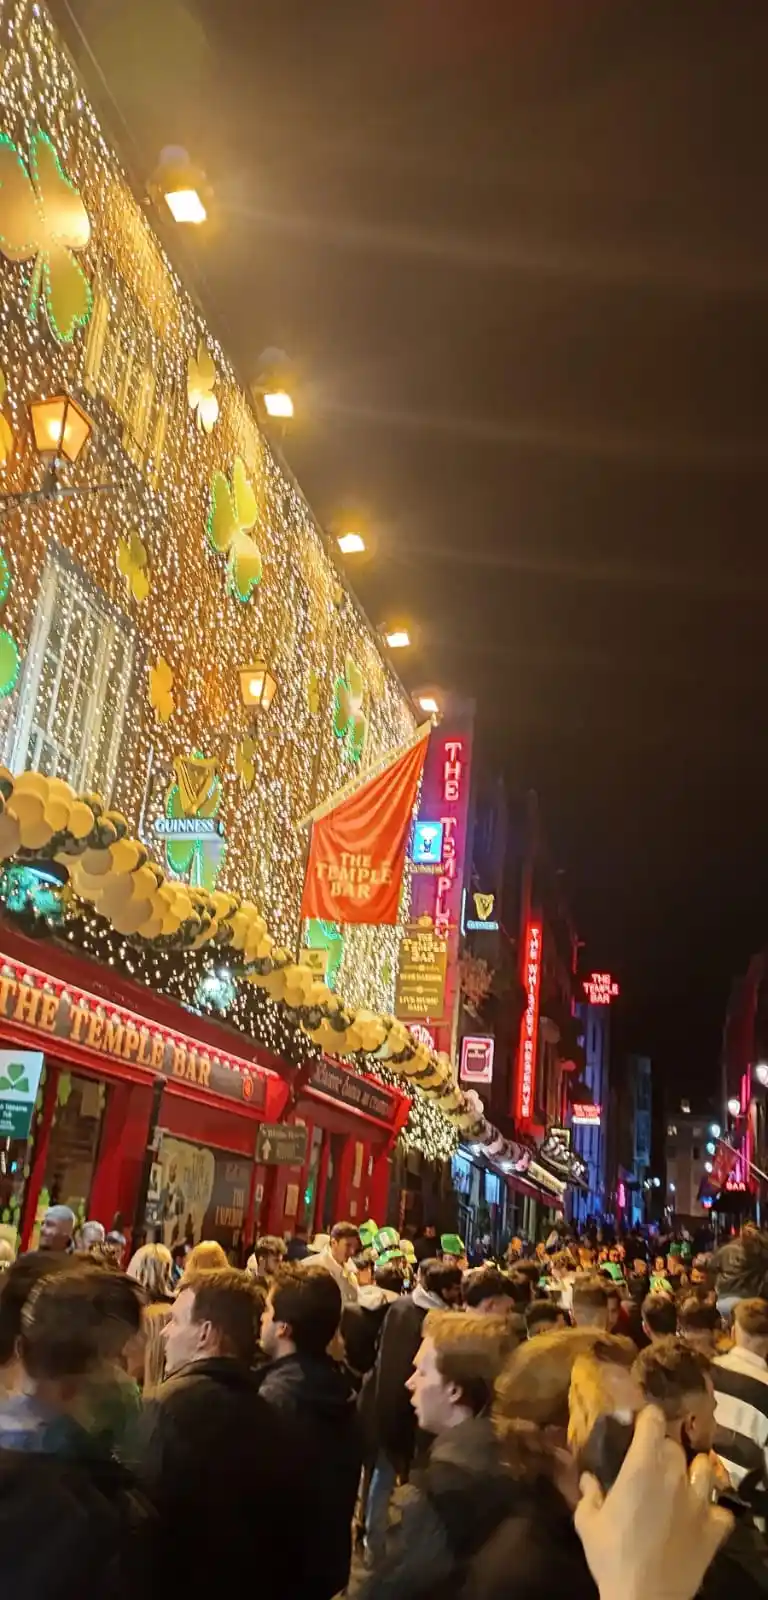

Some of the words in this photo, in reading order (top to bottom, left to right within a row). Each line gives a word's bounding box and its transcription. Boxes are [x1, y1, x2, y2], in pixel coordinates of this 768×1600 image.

[443, 741, 461, 800] THE
[154, 818, 214, 832] GUINNESS
[340, 852, 371, 867] THE
[316, 861, 392, 885] TEMPLE
[331, 881, 370, 898] BAR
[530, 928, 540, 960] THE
[592, 973, 610, 984] THE
[583, 982, 618, 995] TEMPLE
[591, 993, 610, 1004] BAR
[0, 975, 60, 1033] THE
[70, 1004, 165, 1070] TEMPLE
[172, 1047, 212, 1087] BAR
[727, 1181, 746, 1191] BAR
